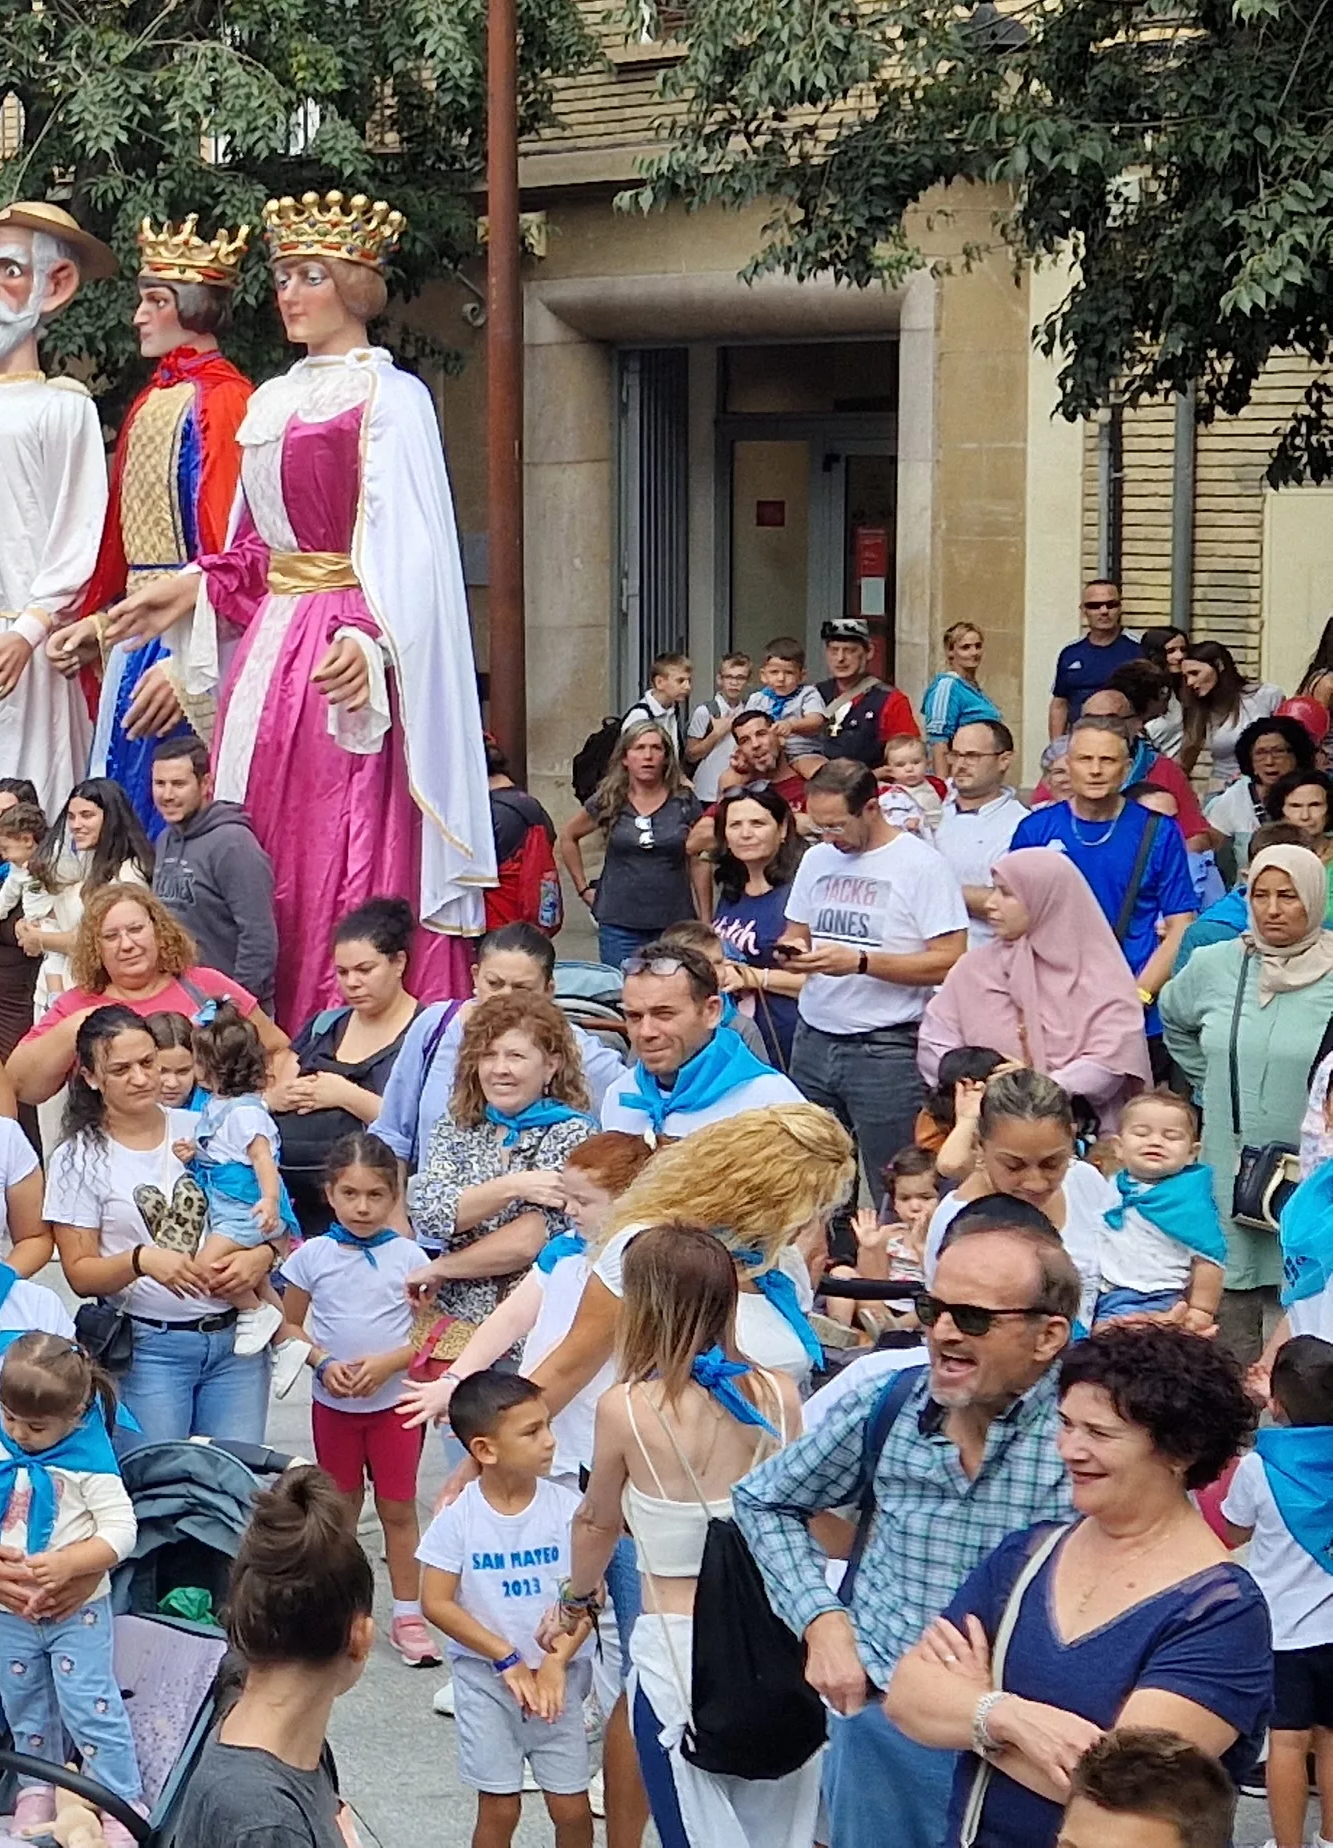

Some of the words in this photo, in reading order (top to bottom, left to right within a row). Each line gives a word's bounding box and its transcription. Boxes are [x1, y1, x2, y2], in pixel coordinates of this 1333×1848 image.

[816, 909, 871, 938] JONES
[472, 1553, 506, 1570] SAN
[510, 1545, 560, 1569] MATEO
